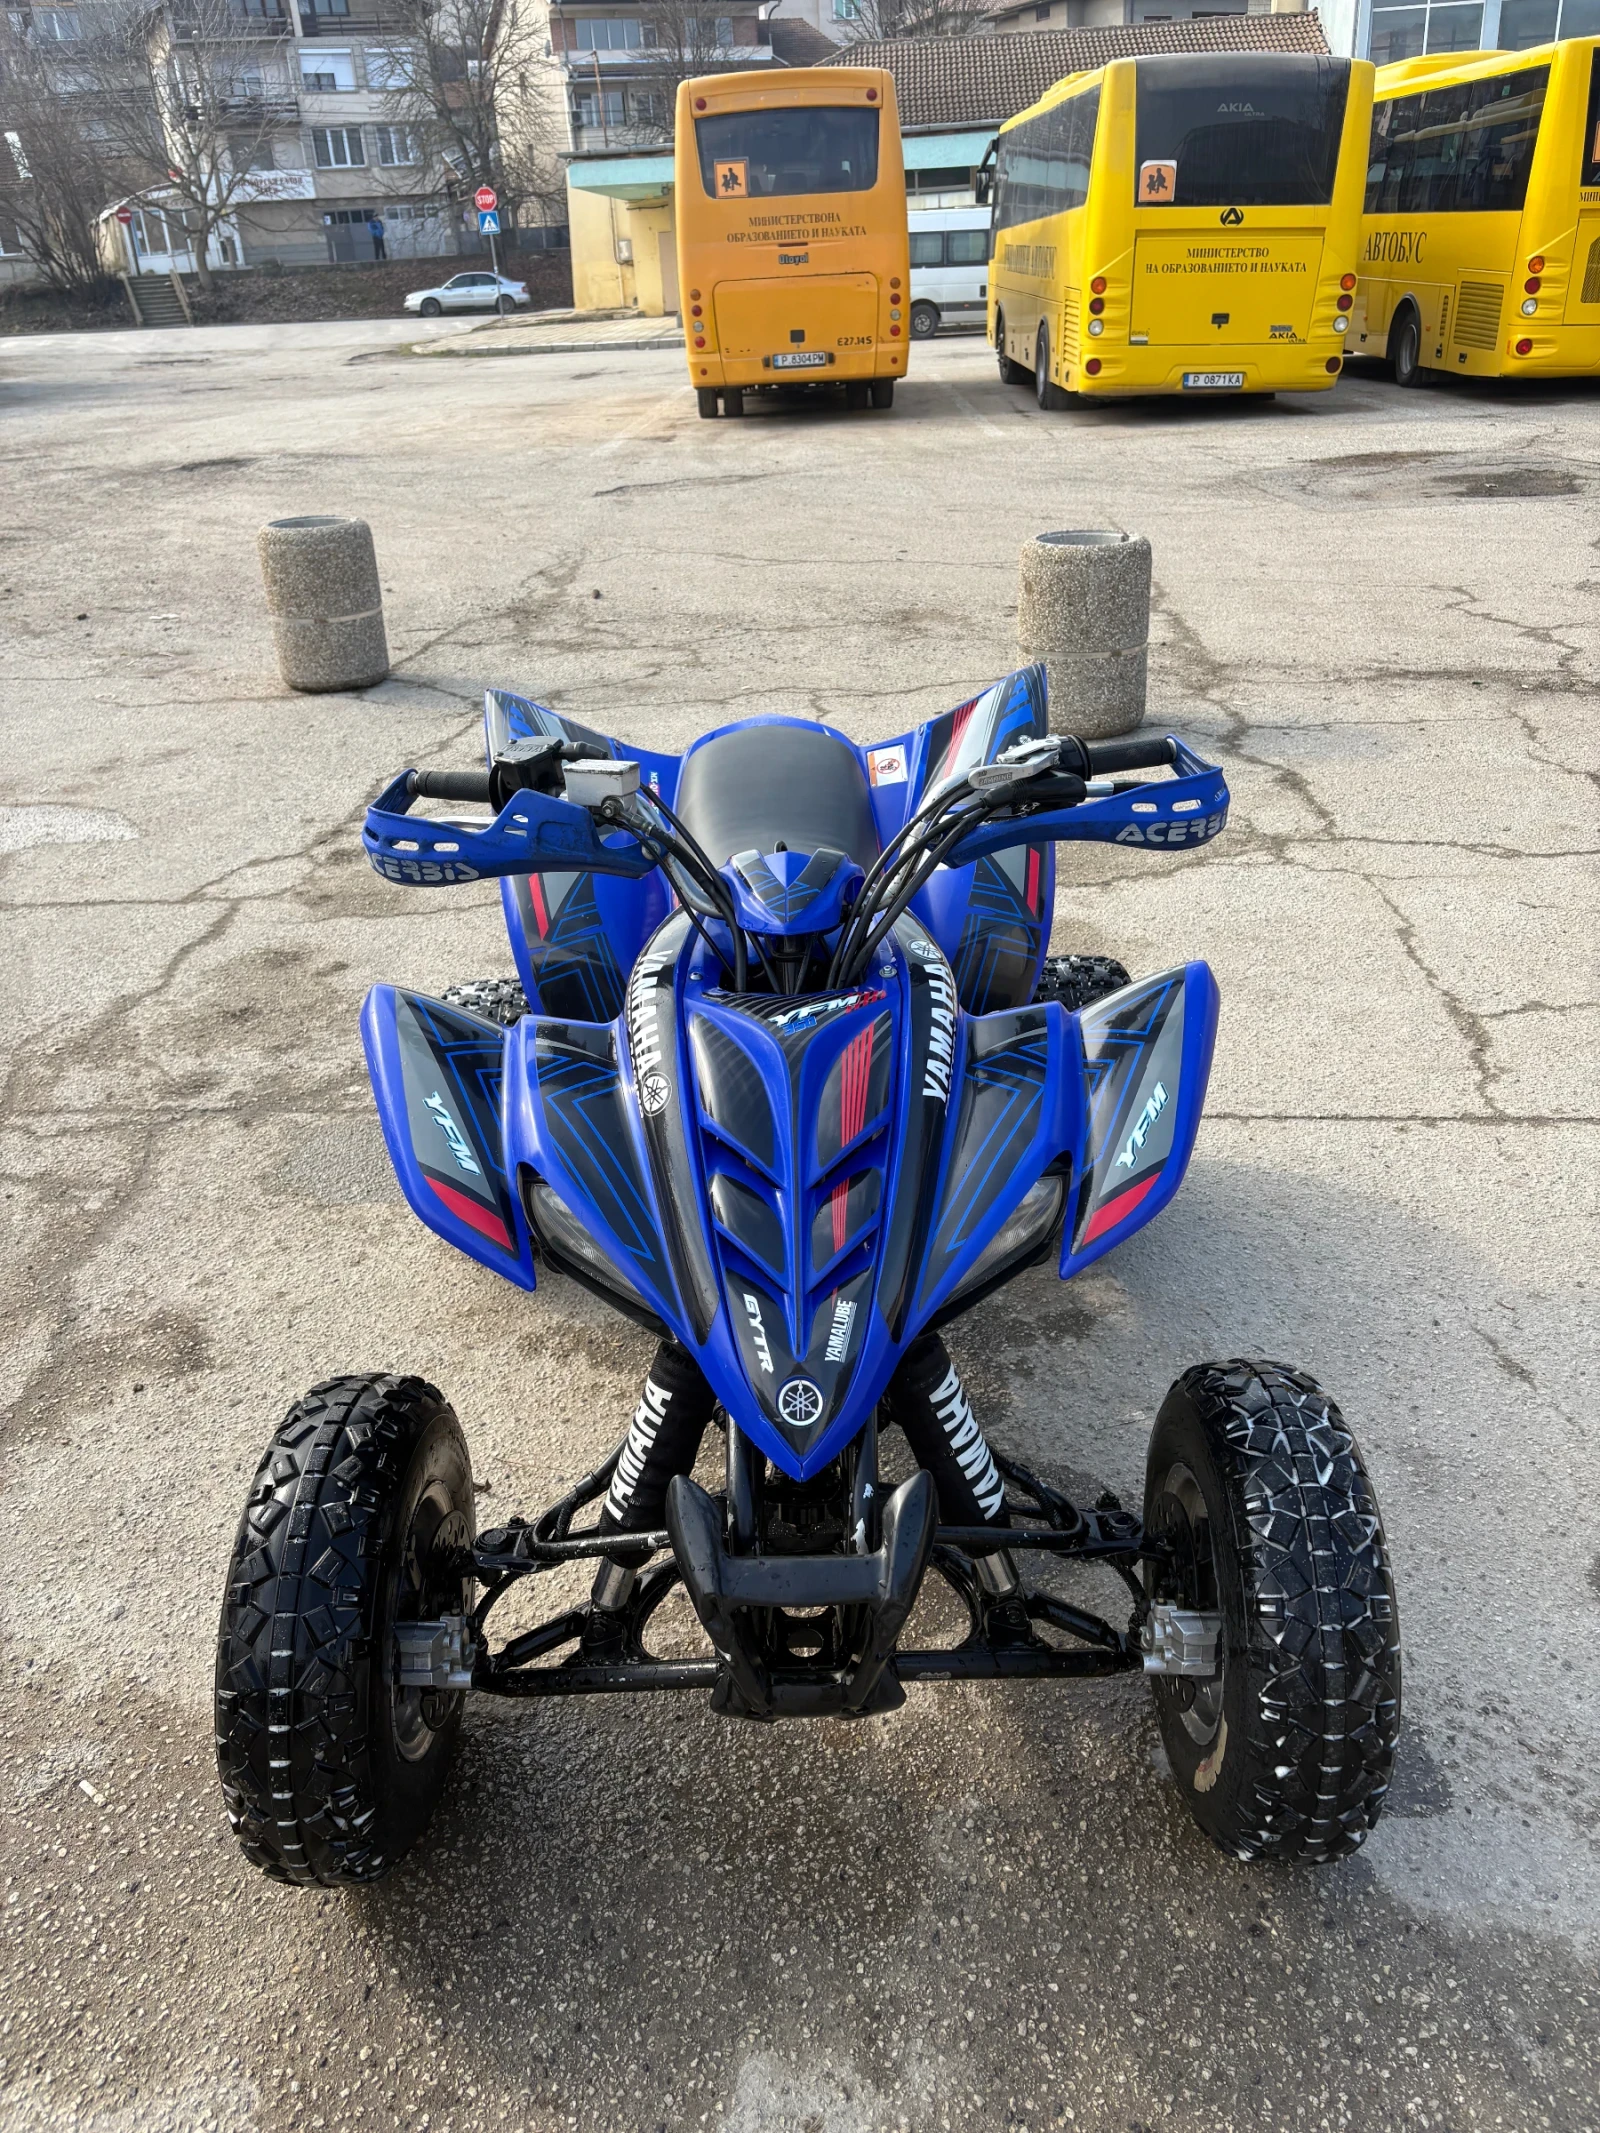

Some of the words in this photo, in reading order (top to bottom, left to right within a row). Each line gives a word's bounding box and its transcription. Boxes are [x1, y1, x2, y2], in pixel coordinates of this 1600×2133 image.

[1217, 103, 1254, 112] AKIA
[477, 195, 494, 204] STOP
[727, 229, 810, 243] ОБРАЗОВАНИЕТО
[812, 228, 819, 238] И
[822, 226, 867, 238] НАУКАТА
[1186, 247, 1269, 259] МИНИСТЕРСТВО
[1363, 232, 1427, 263] АВТОБУС
[1145, 263, 1159, 273] НА
[1161, 262, 1248, 273] ОБРАЗОВАНИЕТО
[1250, 263, 1257, 272] И
[1260, 262, 1307, 273] НАУКАТА
[632, 950, 673, 1081] YAMAHA
[768, 995, 859, 1028] YFM
[922, 963, 954, 1103] YAMAHA
[422, 1090, 481, 1175] YFM
[1115, 1081, 1169, 1168] YFM
[743, 1292, 774, 1374] GYTR
[824, 1297, 852, 1362] YAMALUBE
[928, 1361, 1004, 1521] YAMAHA
